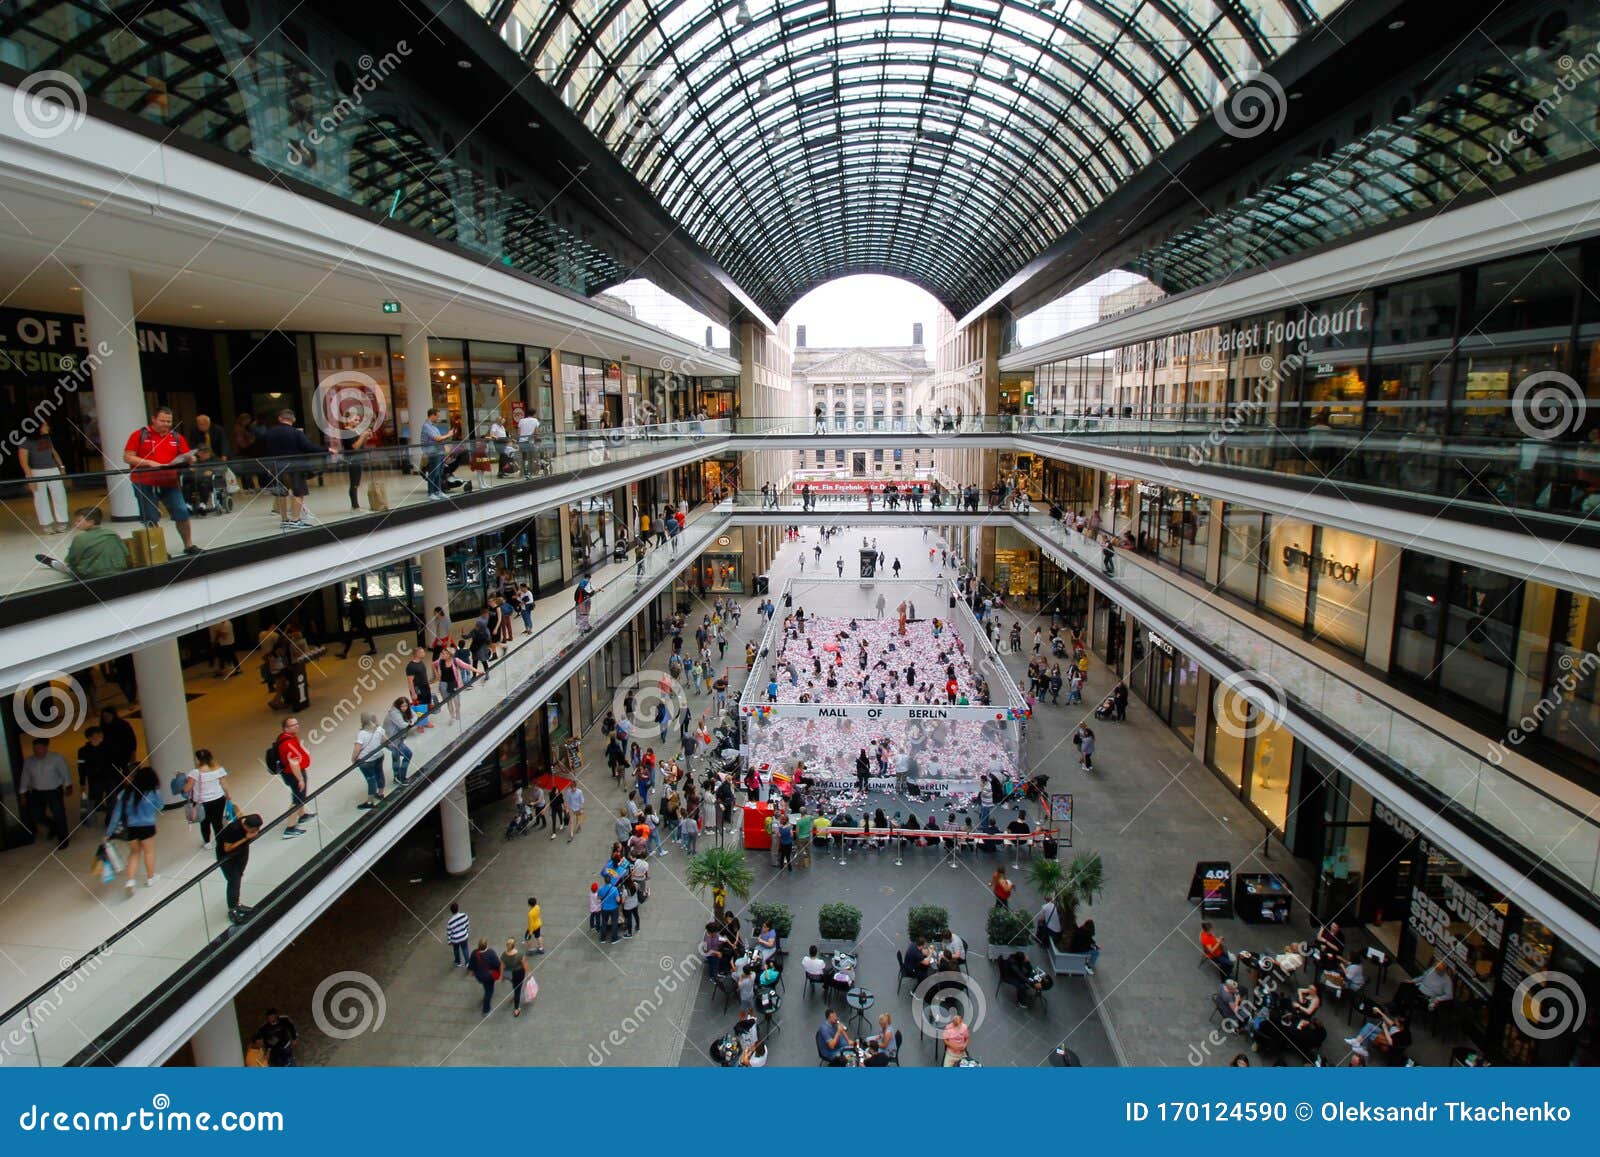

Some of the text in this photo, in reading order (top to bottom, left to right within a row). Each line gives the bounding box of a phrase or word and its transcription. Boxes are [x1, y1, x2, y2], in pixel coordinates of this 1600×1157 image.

[16, 317, 169, 353] OF BIN
[1266, 302, 1368, 344] Foodcourt
[818, 708, 947, 719] MALL OF BERLIN
[1374, 802, 1418, 841] SOUP
[1412, 885, 1451, 928] ICED
[1441, 873, 1505, 934] FRESH
[1445, 897, 1501, 951] JUICE
[1410, 900, 1469, 961] SHAKE
